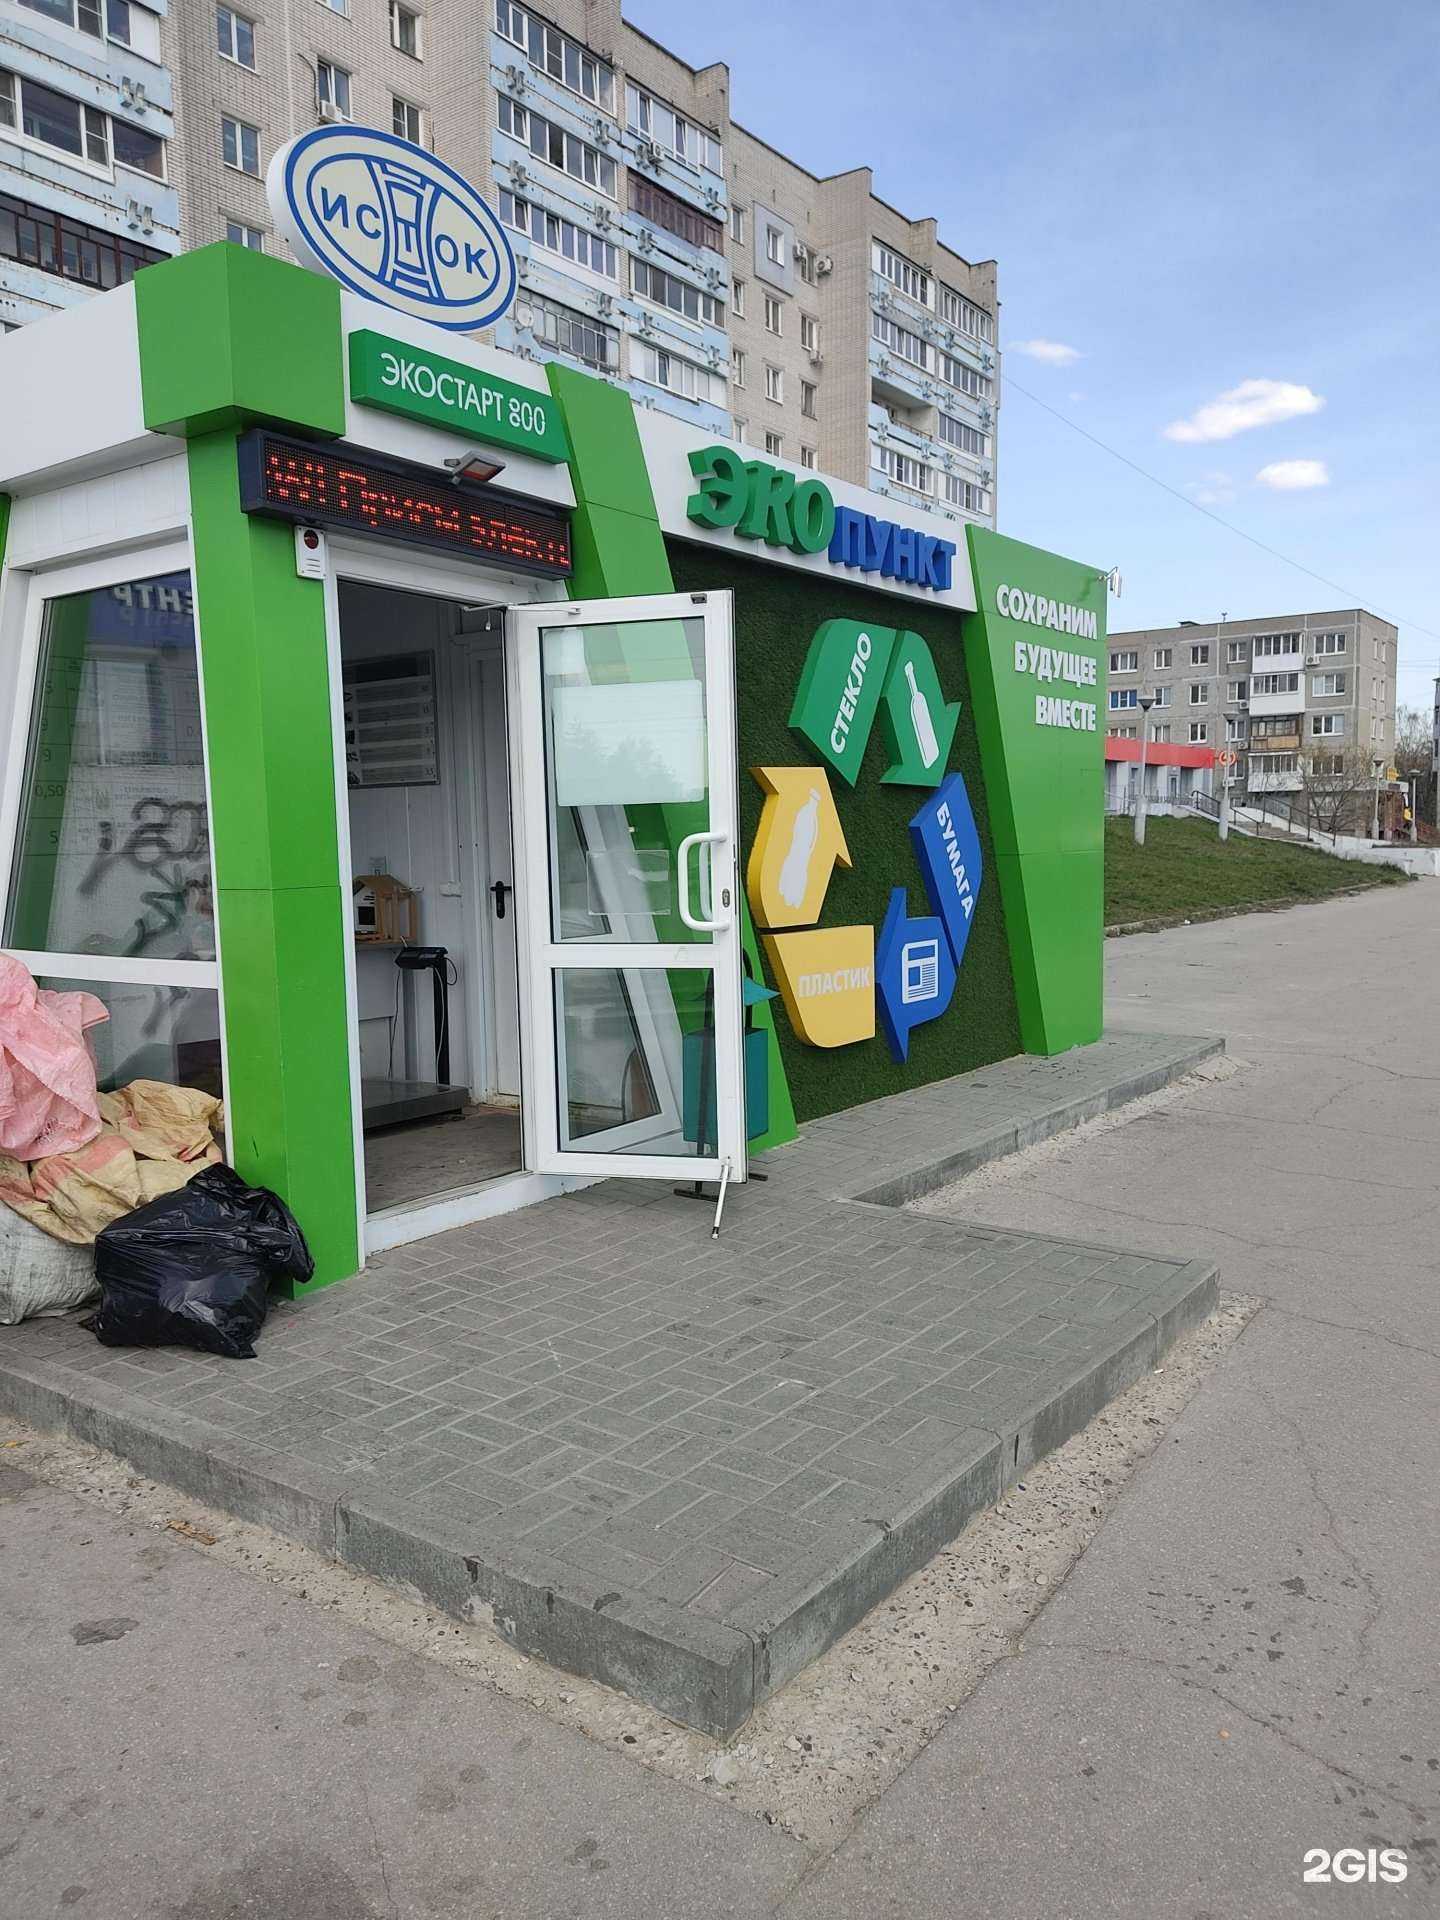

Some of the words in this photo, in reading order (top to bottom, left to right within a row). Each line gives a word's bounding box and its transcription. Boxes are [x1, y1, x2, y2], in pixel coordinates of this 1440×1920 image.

[320, 186, 490, 281] ИСТОК
[380, 352, 504, 421] ЭКОСТАРТ
[508, 398, 547, 436] 800
[996, 583, 1098, 641] СОХРАНИМ
[829, 631, 873, 755] СТЕКЛО
[1014, 641, 1098, 691] БУДУЩЕЕ
[1035, 695, 1098, 732] ВМЕСТЕ
[935, 800, 974, 921] БУМАГА
[799, 965, 871, 998] ПЛАСТИК
